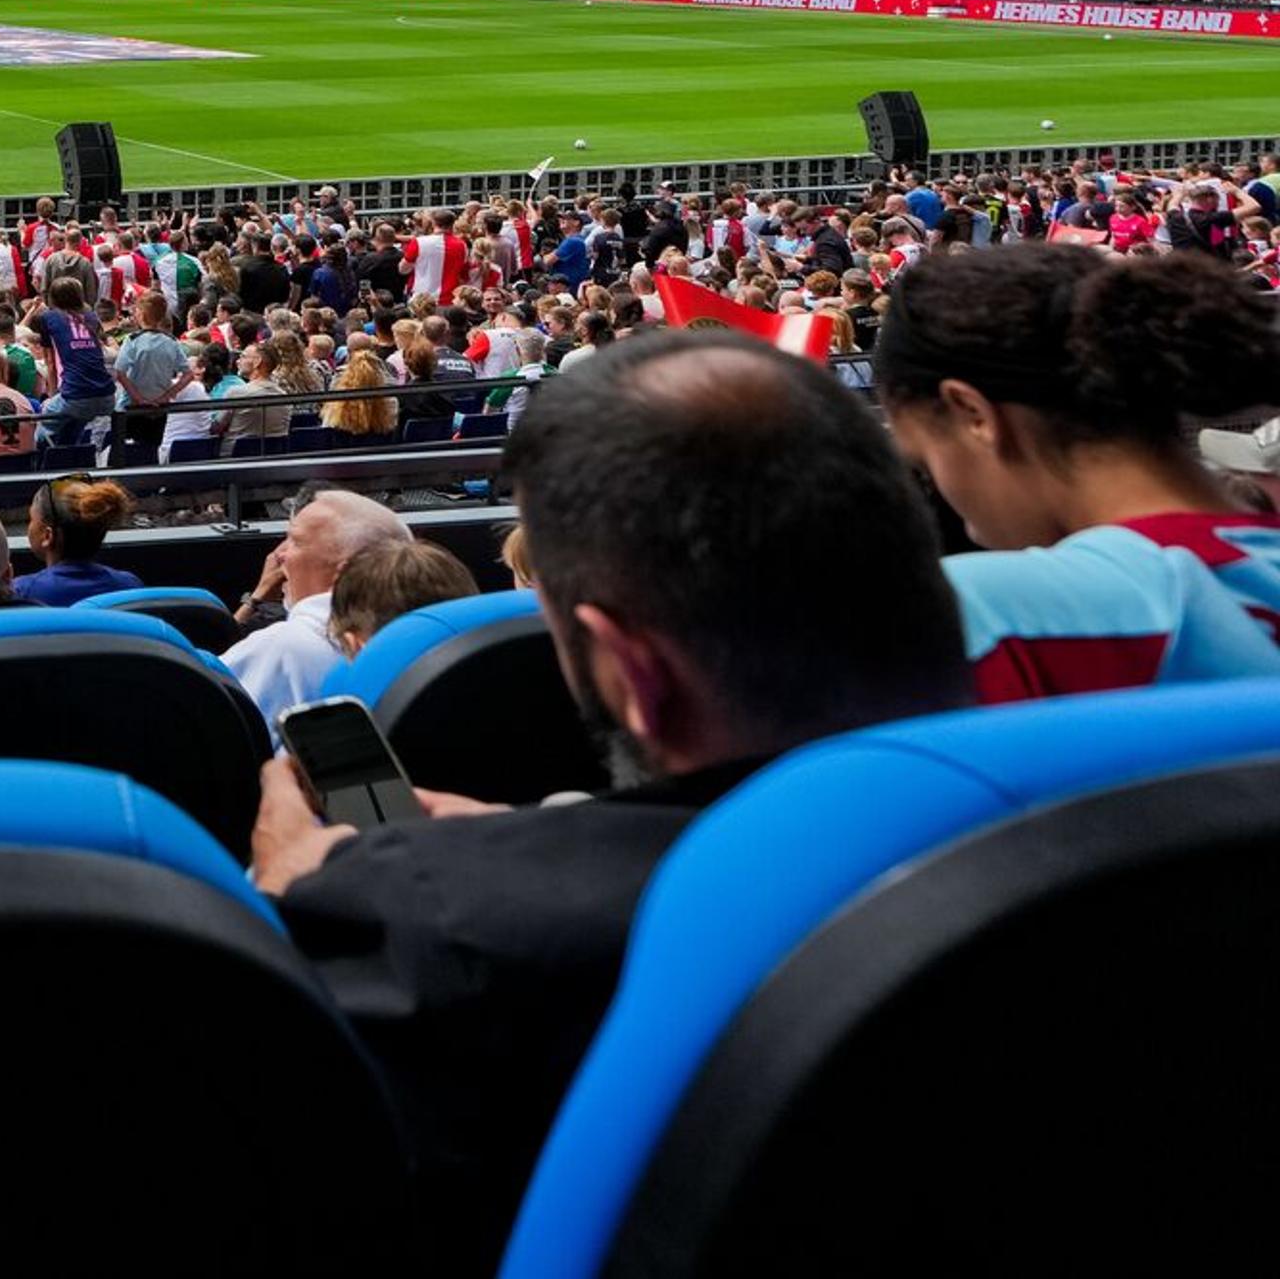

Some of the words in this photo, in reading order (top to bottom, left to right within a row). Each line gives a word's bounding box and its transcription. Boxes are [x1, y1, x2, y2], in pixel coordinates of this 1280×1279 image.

[994, 1, 1080, 22] HERMES
[1082, 4, 1159, 27] HOUSE
[1160, 8, 1233, 33] BAND
